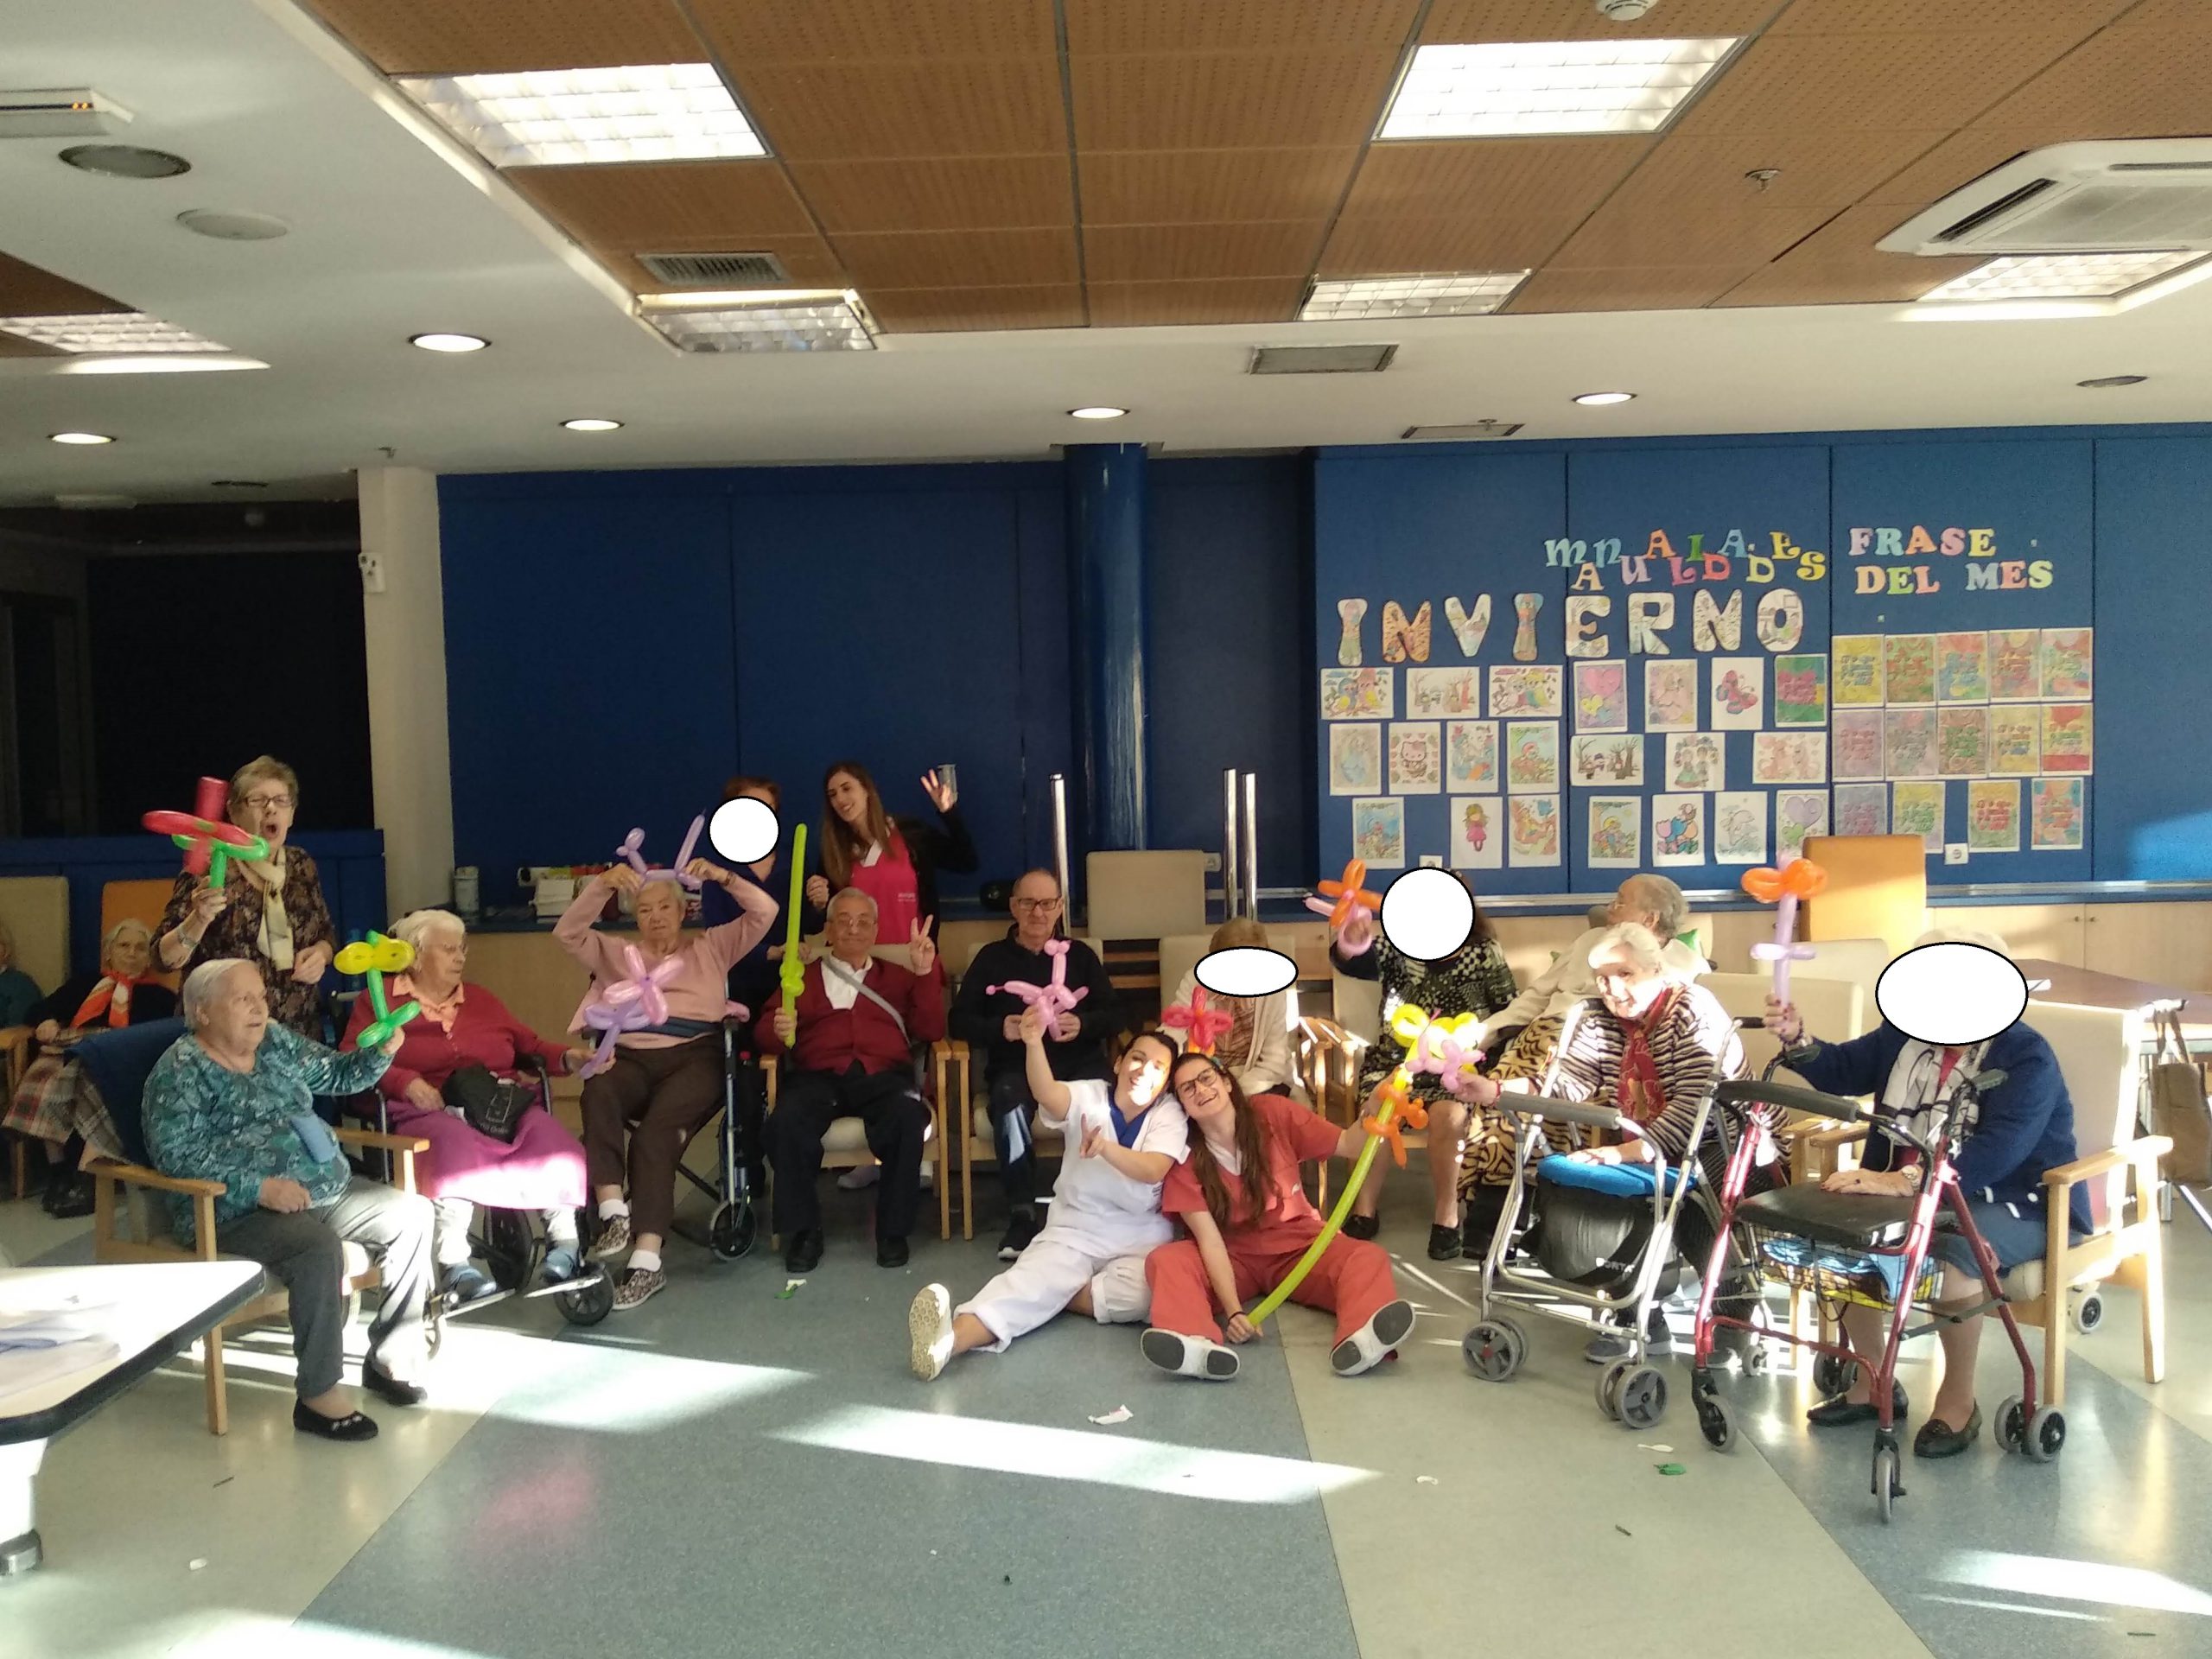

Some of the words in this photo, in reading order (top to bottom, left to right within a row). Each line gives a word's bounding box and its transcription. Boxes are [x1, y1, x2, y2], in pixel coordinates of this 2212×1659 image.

[1848, 525, 1996, 557] FRASE
[1854, 564, 1941, 594] DEL
[1965, 560, 2054, 591] MES
[1337, 588, 1804, 667] INVIERNO
